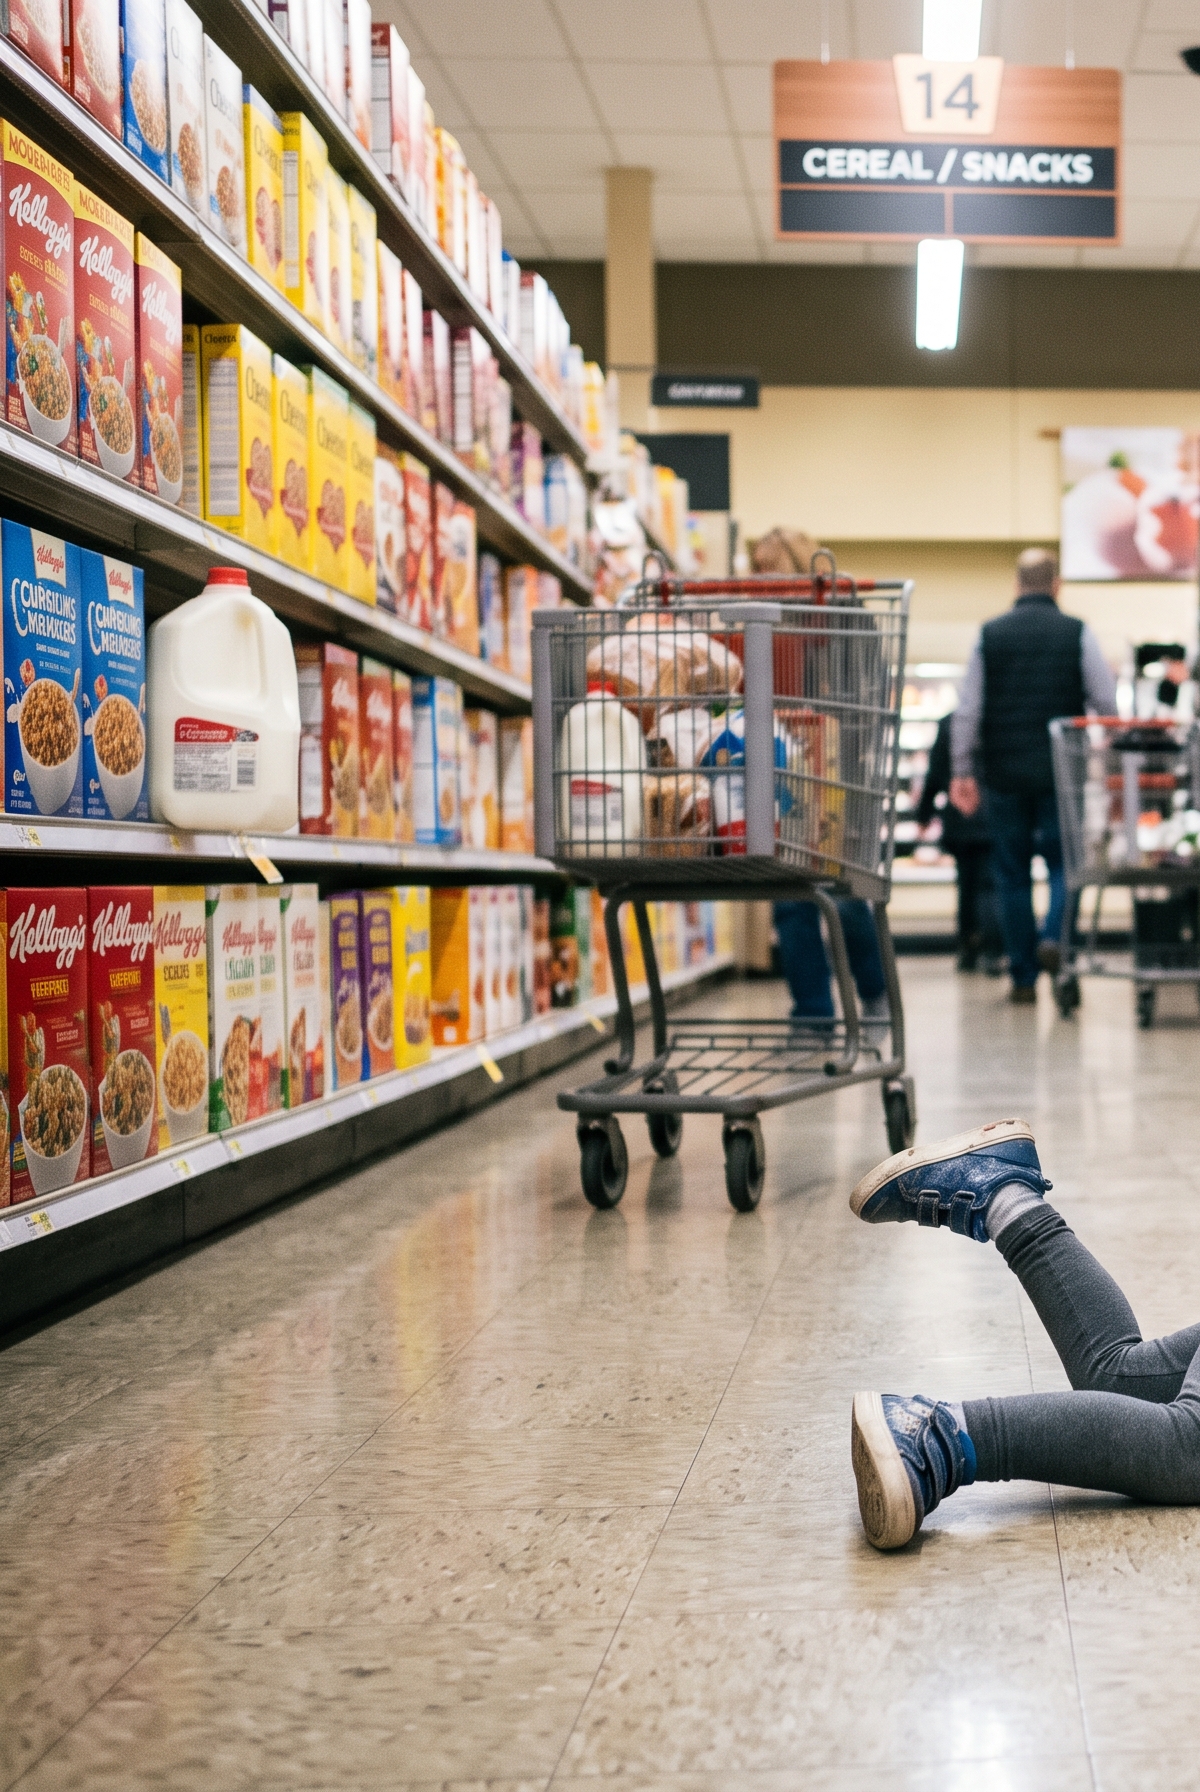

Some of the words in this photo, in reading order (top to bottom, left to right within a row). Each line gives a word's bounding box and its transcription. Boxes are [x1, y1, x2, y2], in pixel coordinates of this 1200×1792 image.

[915, 71, 979, 120] 14
[802, 147, 934, 181] CEREAL
[936, 149, 958, 184] /
[962, 151, 1094, 184] SNACKS
[9, 182, 71, 259] Kellogg's
[79, 235, 133, 304] Kellogg's
[10, 903, 86, 970] Kellogg's
